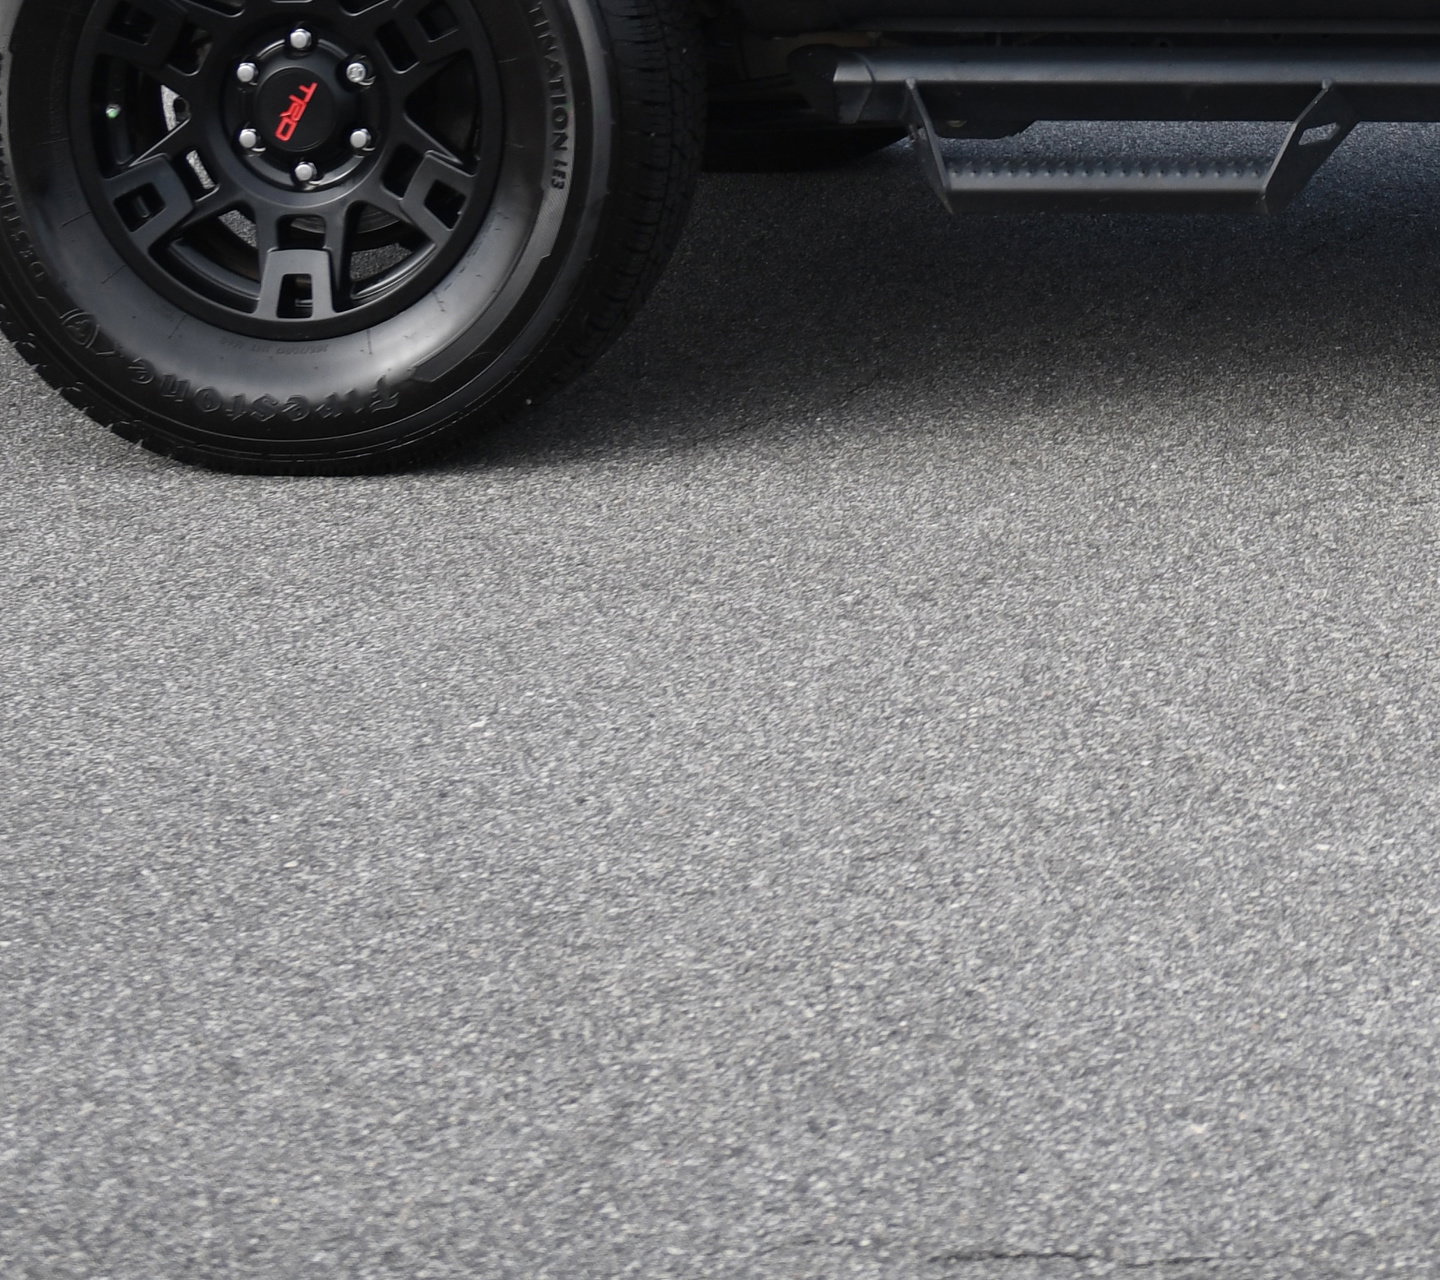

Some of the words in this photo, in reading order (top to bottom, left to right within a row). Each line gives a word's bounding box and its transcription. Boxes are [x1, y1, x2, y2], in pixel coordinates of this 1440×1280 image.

[274, 81, 319, 142] TRD
[551, 159, 568, 190] LE3
[128, 356, 401, 422] Firestone
